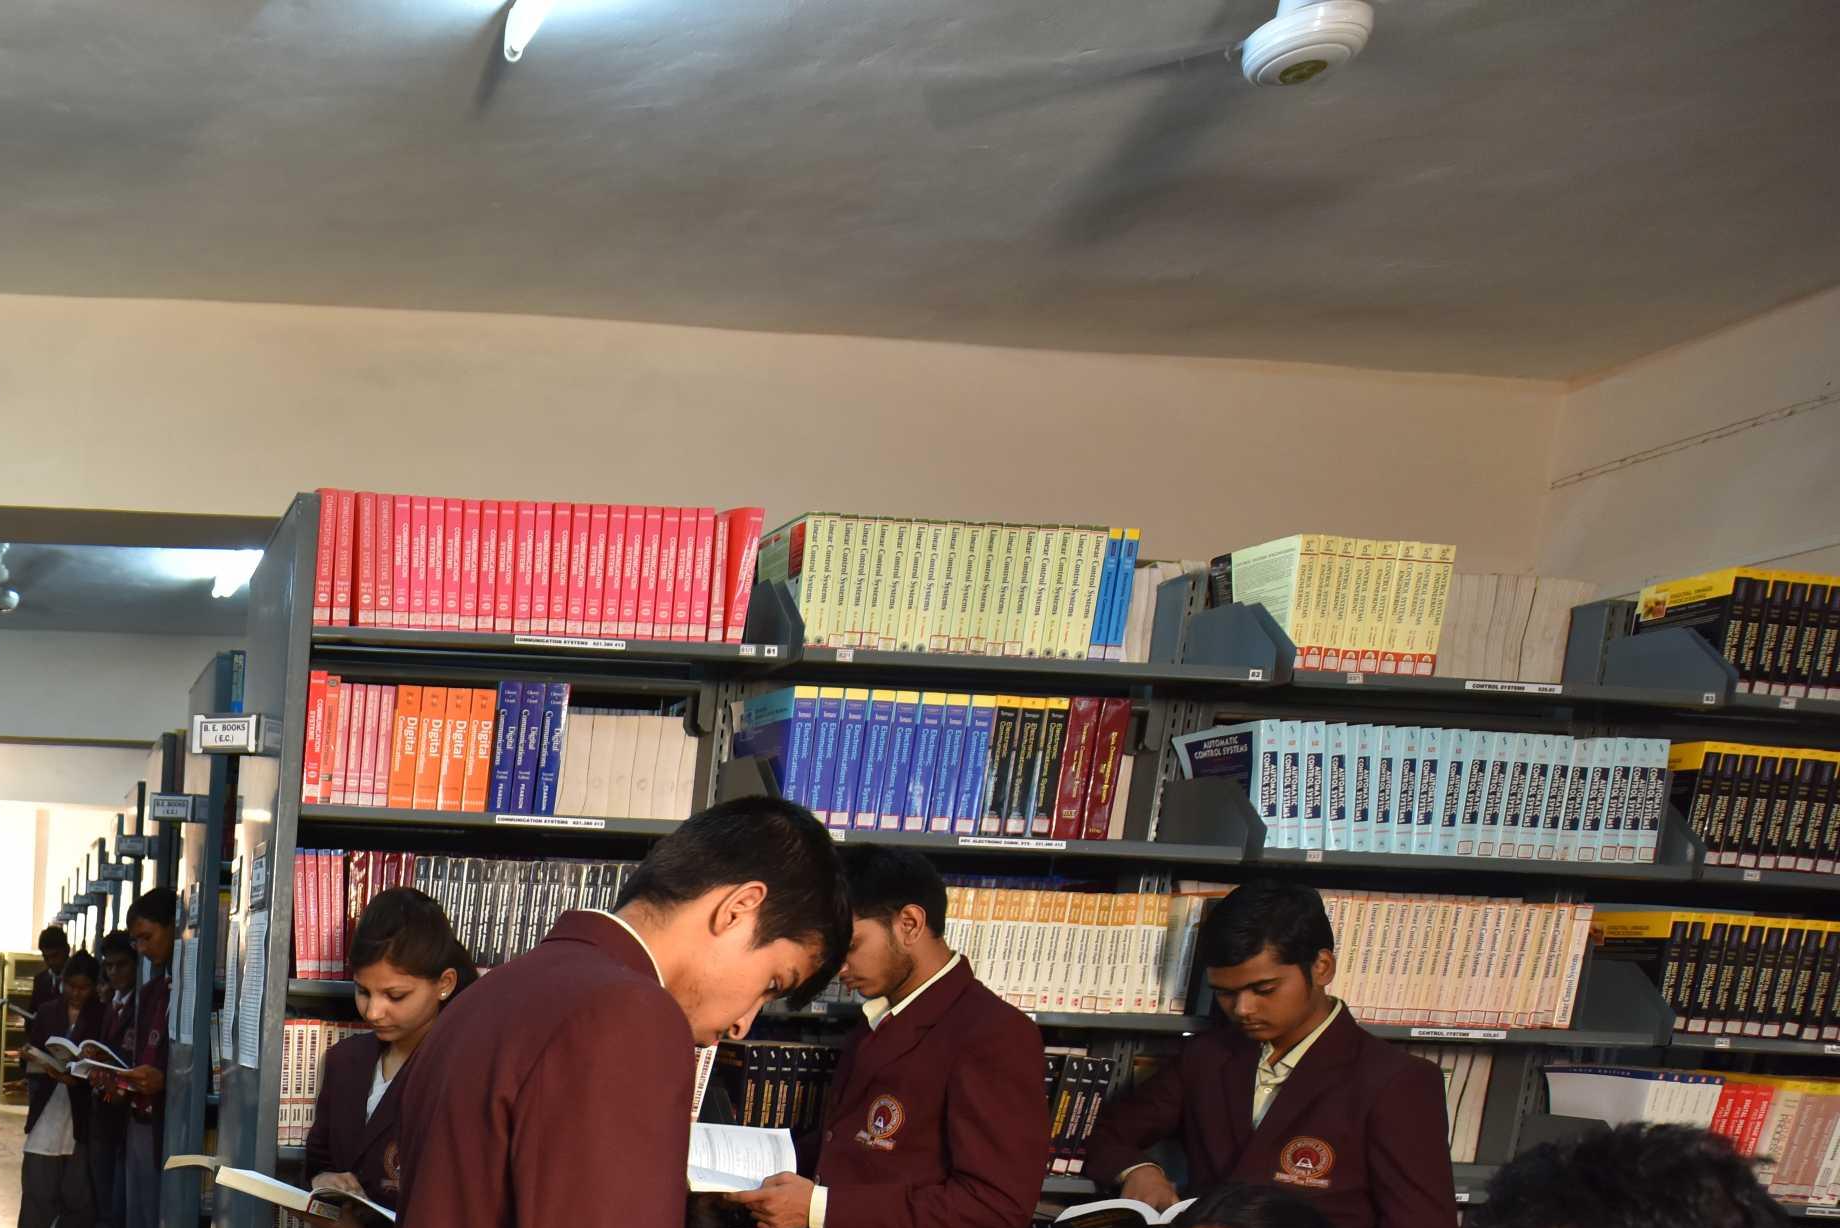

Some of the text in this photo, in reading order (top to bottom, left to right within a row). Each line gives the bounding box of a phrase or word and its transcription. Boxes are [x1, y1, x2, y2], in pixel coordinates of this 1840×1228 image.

[821, 520, 837, 603] Linear Control Systems
[889, 526, 907, 609] Linear Control Systems
[515, 636, 562, 645] COMMUNICATION
[222, 723, 246, 731] BOOKS
[404, 717, 418, 755] Digital
[453, 720, 467, 758] Digital
[495, 709, 507, 766] Communications
[506, 726, 516, 750] Digital
[1203, 735, 1239, 750] AUTOMATIC
[1194, 743, 1248, 760] CONTROL SYSTEMS
[1282, 755, 1292, 818] CONTROL SYSTEMS
